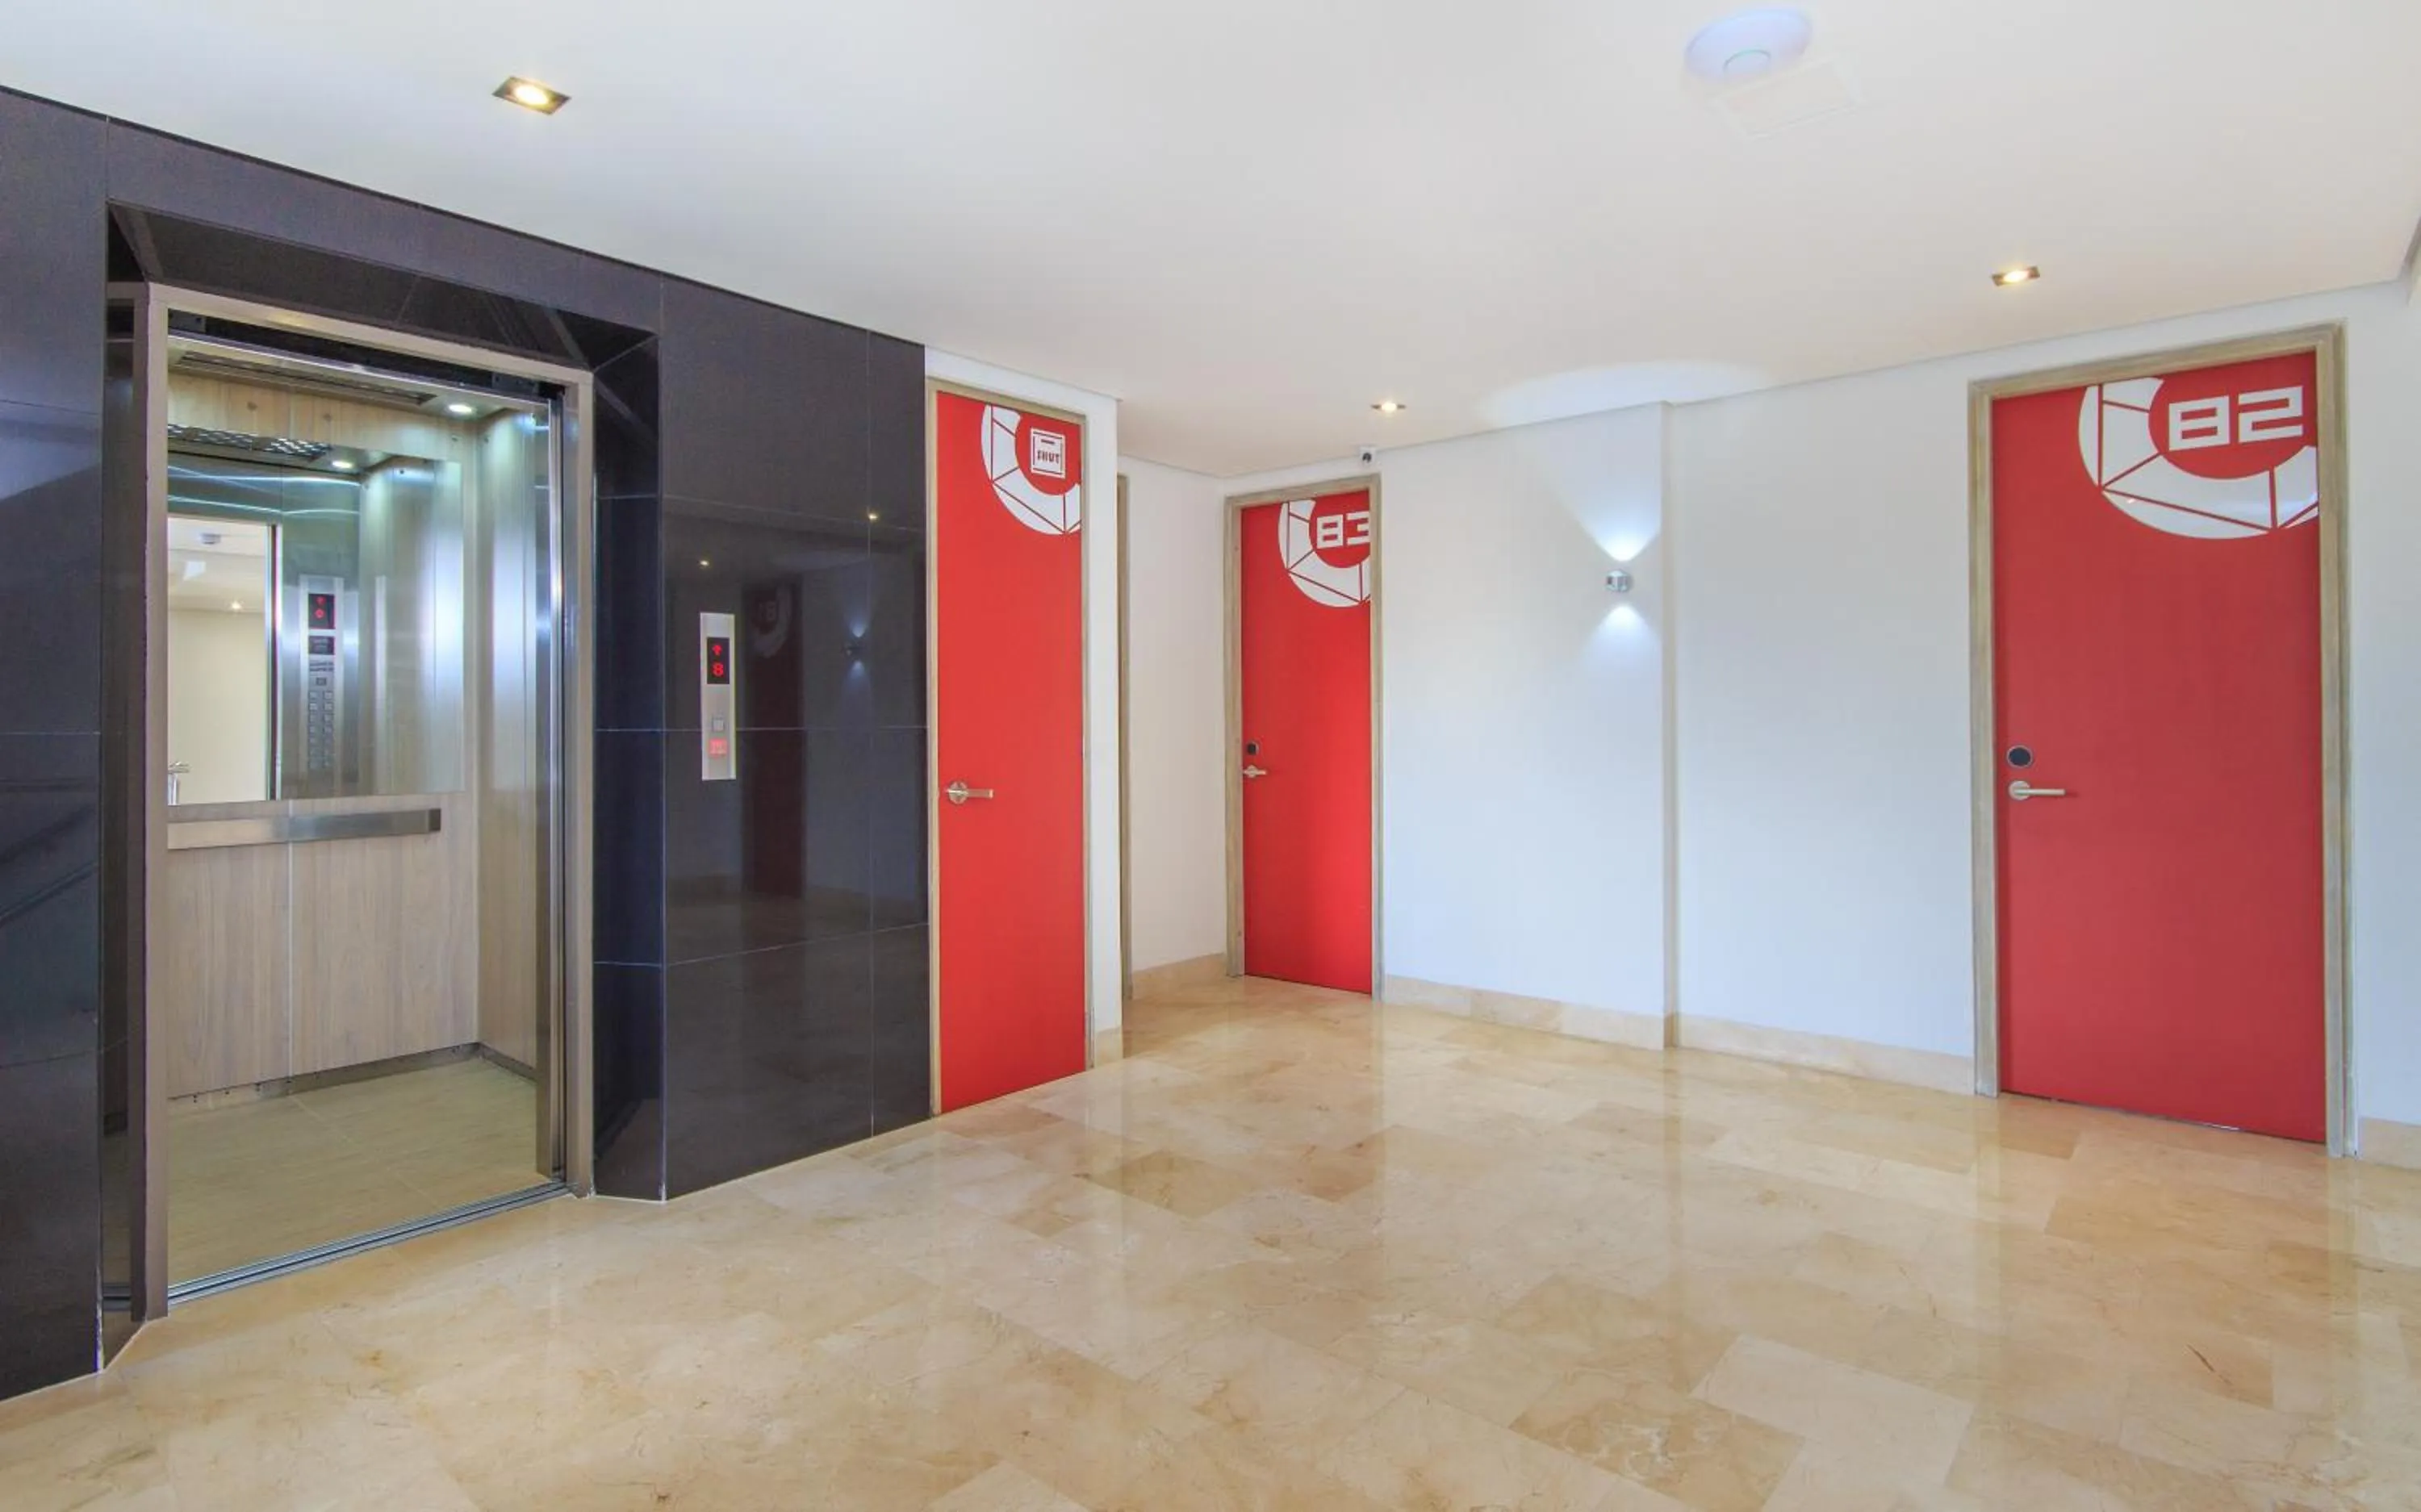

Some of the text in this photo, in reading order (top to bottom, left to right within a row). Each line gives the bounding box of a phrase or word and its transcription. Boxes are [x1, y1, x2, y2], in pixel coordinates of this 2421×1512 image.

[2168, 386, 2303, 451] 82
[1317, 511, 1370, 549] 83
[713, 662, 724, 677] 8
